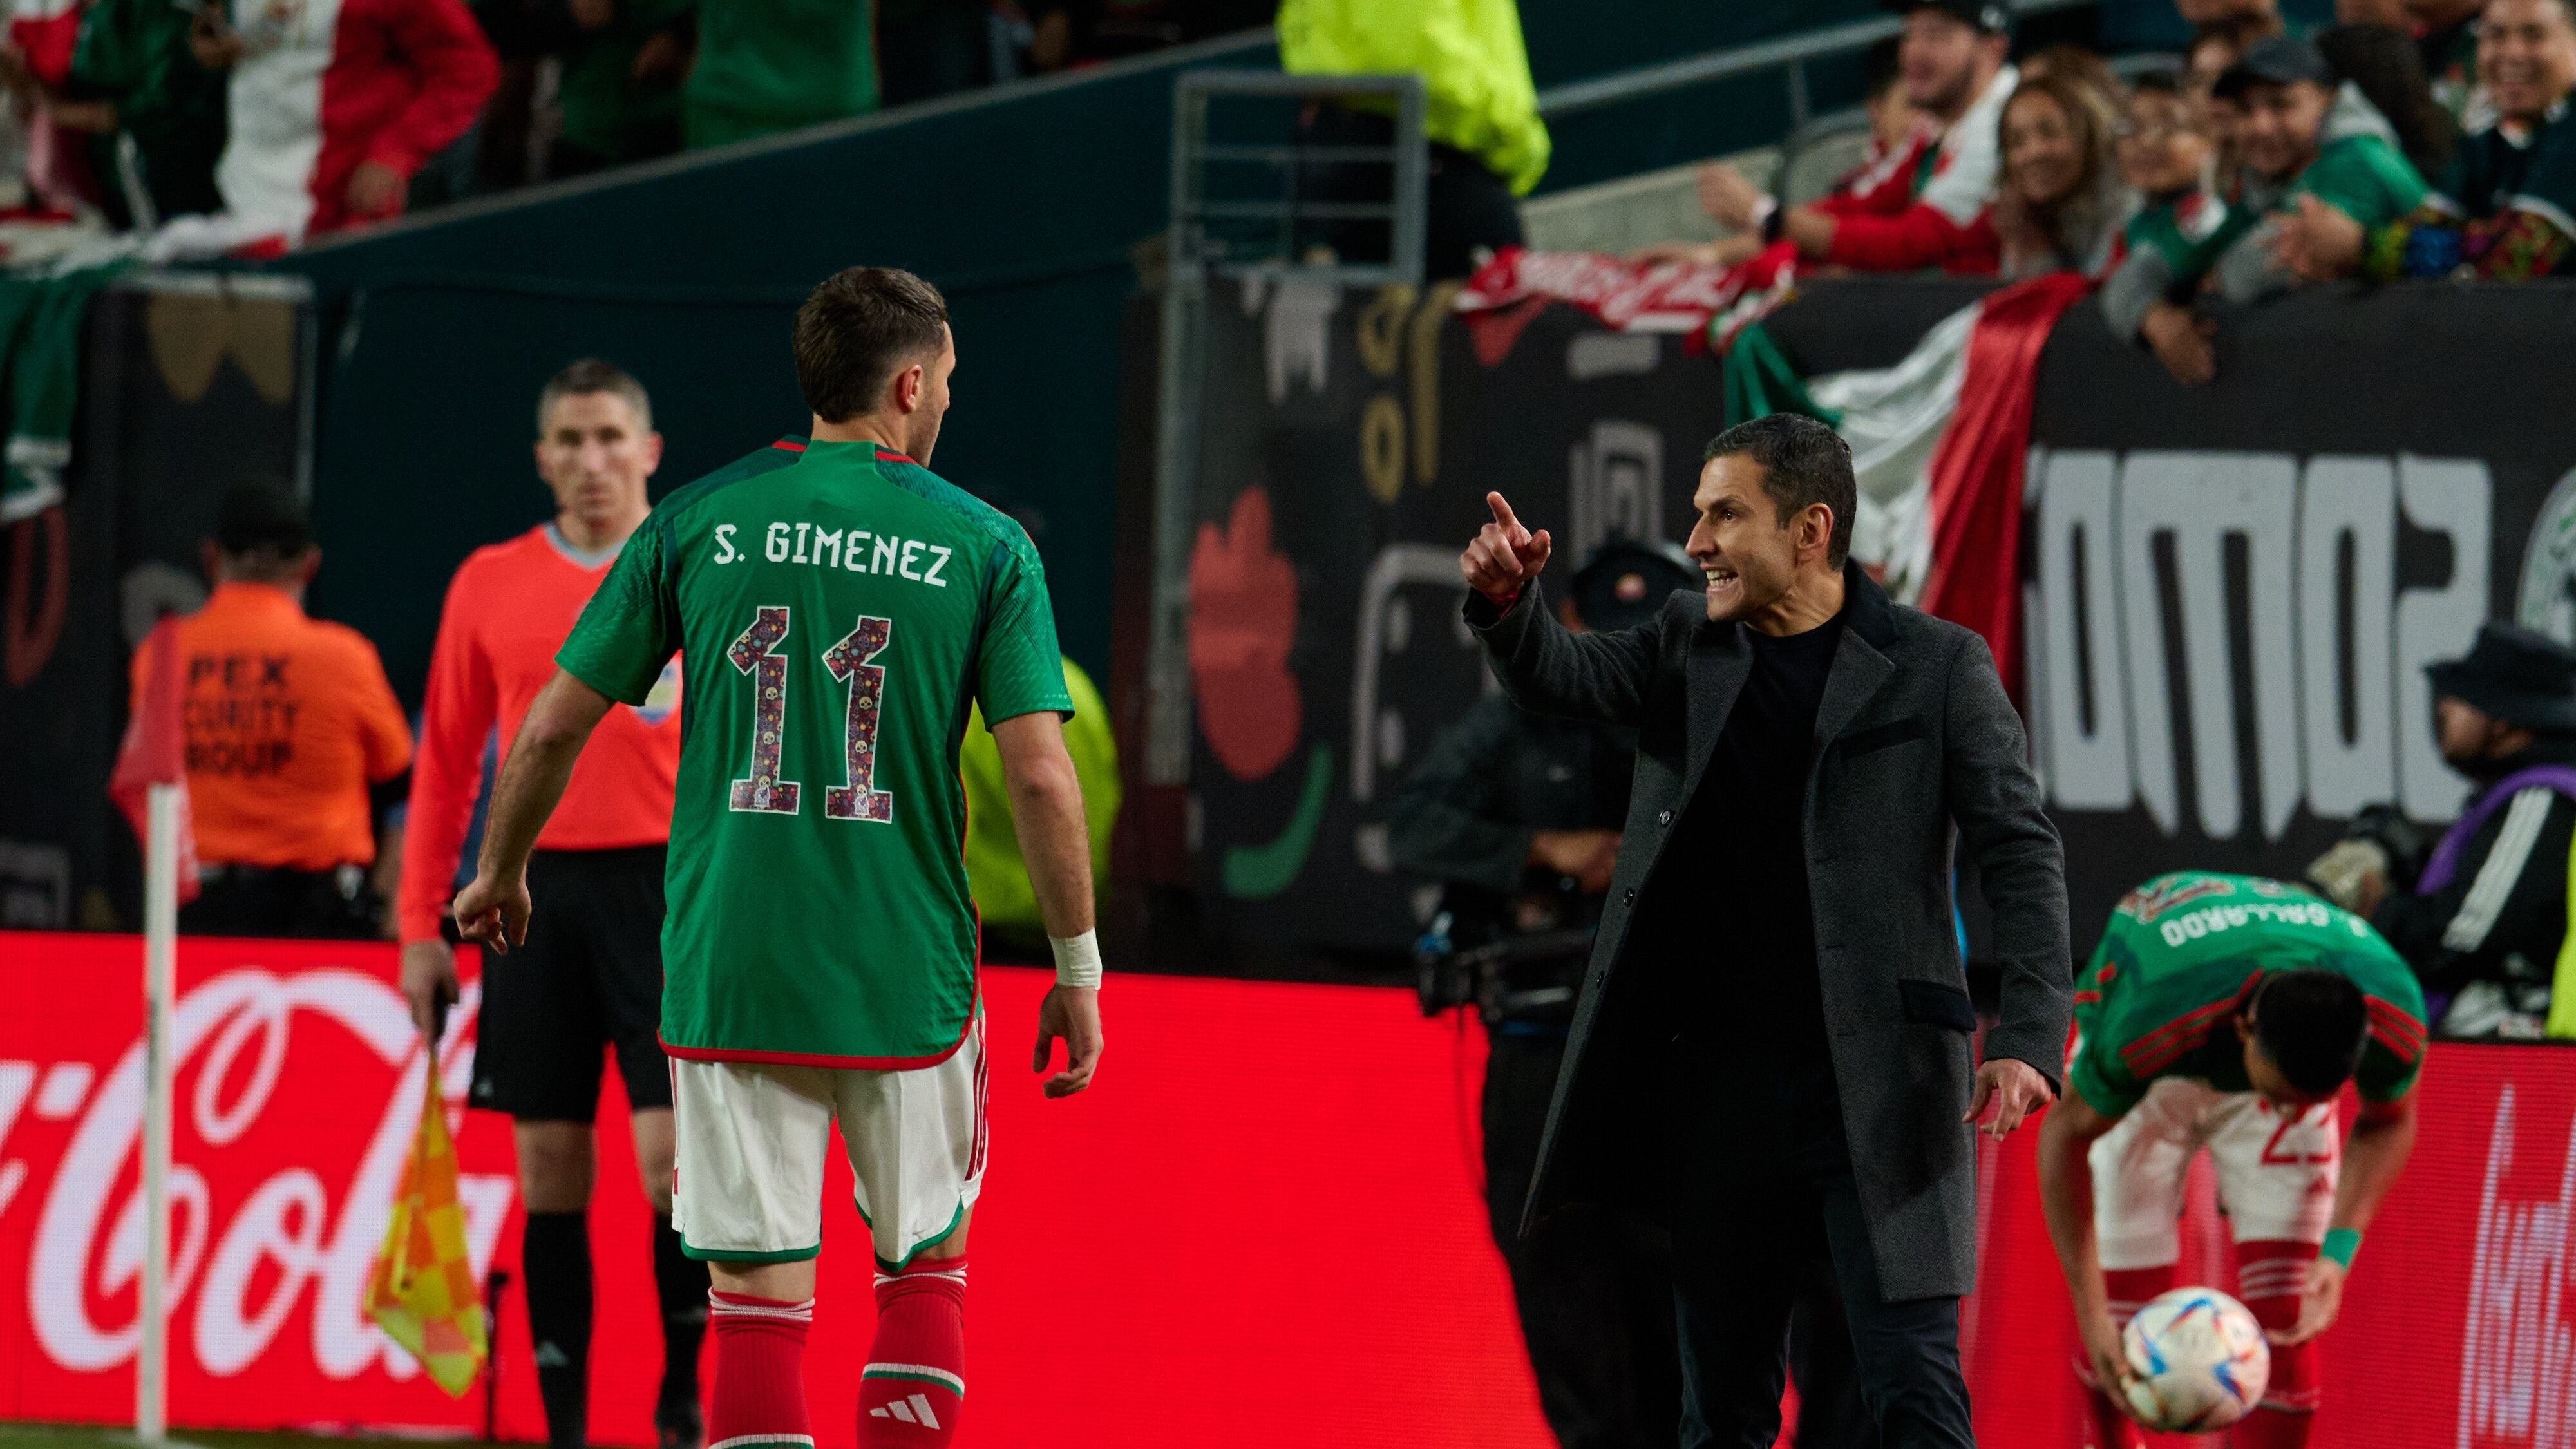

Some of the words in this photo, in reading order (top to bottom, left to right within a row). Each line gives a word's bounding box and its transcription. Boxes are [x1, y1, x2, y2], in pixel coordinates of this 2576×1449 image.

[714, 524, 745, 564] S.
[765, 522, 952, 587] GIMENEZ
[2024, 446, 2491, 840] OMOS
[189, 653, 290, 688] PEX
[183, 698, 299, 733] CURITY
[727, 606, 893, 824] 11
[185, 741, 294, 777] ROUP
